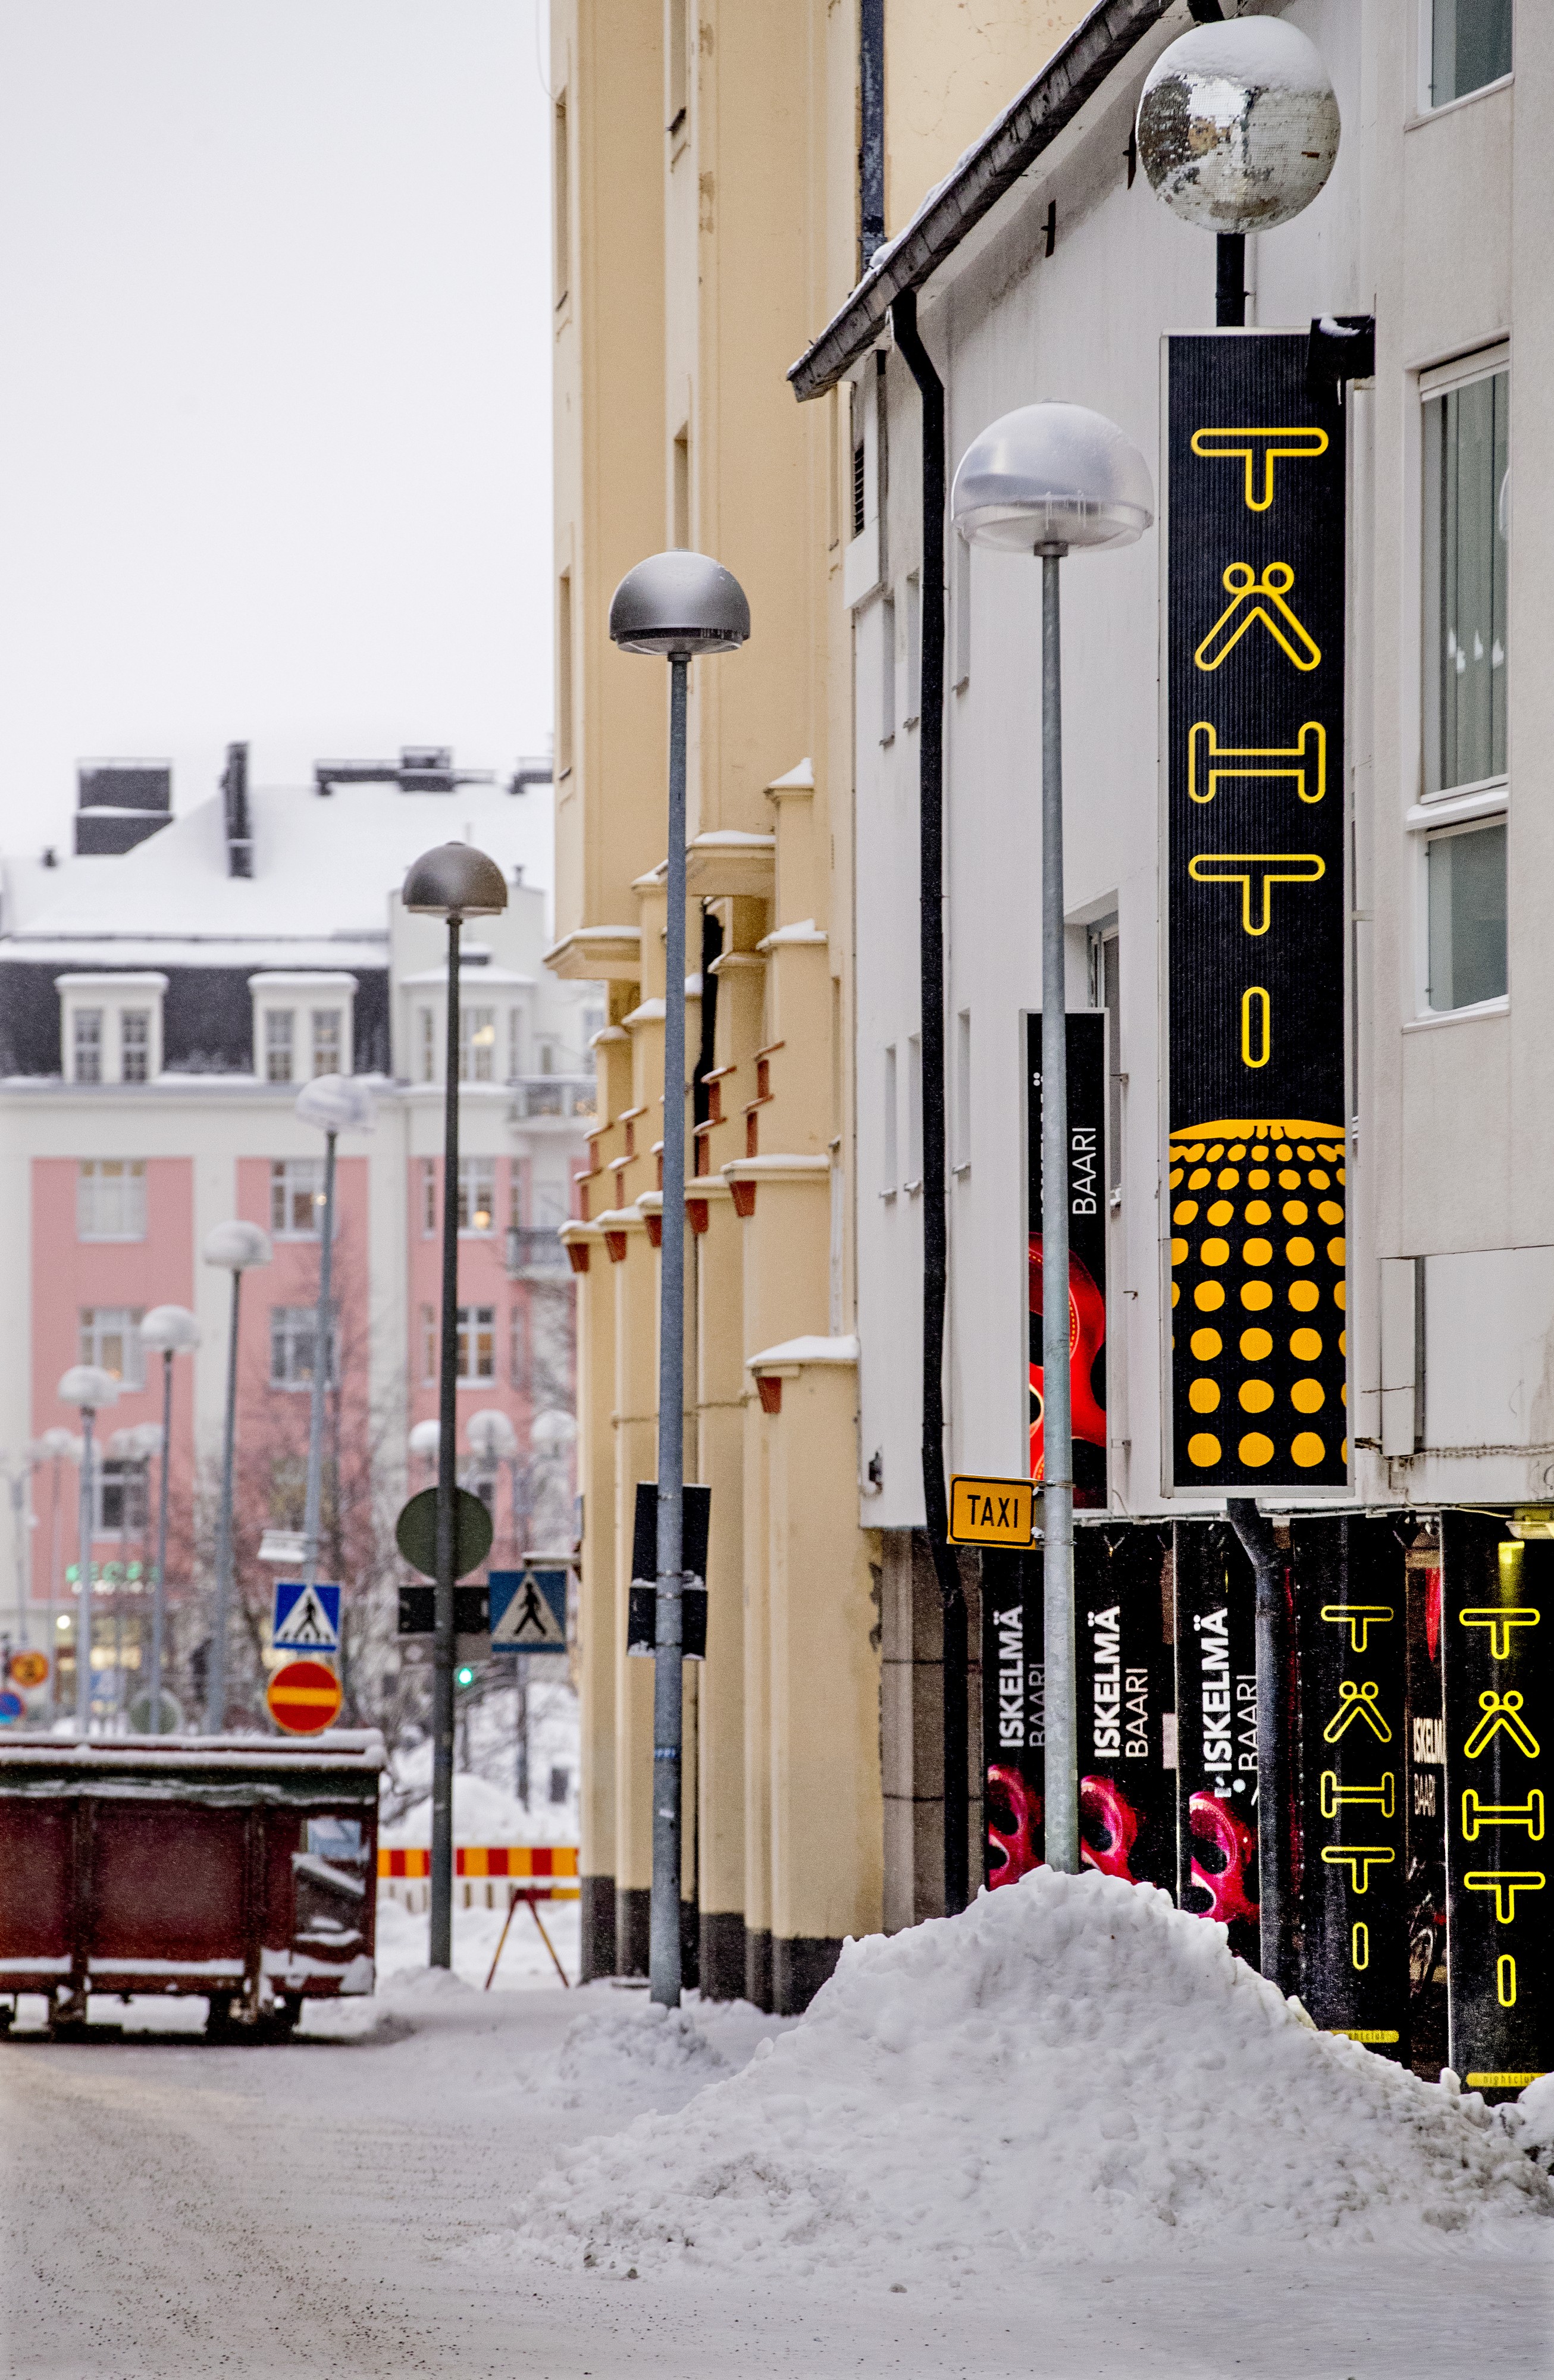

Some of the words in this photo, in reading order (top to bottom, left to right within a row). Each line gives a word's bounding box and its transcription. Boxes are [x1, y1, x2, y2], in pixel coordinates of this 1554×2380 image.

[1188, 428, 1329, 1067] TÄHTI
[1072, 1128, 1096, 1214] BAARI
[967, 1494, 1019, 1528] TAXI
[993, 1605, 1024, 1747] ISKELMÄ
[1028, 1664, 1045, 1747] BAARI
[1088, 1605, 1121, 1758] ISKELMÄ
[1125, 1668, 1149, 1758] BAARI
[1193, 1608, 1233, 1772] ISKELMÄ
[1236, 1674, 1258, 1771] BAARI
[1320, 1605, 1395, 1969] TÄHTI
[1413, 1717, 1447, 1764] ISKELM
[1459, 1608, 1546, 2007] TÄHTI
